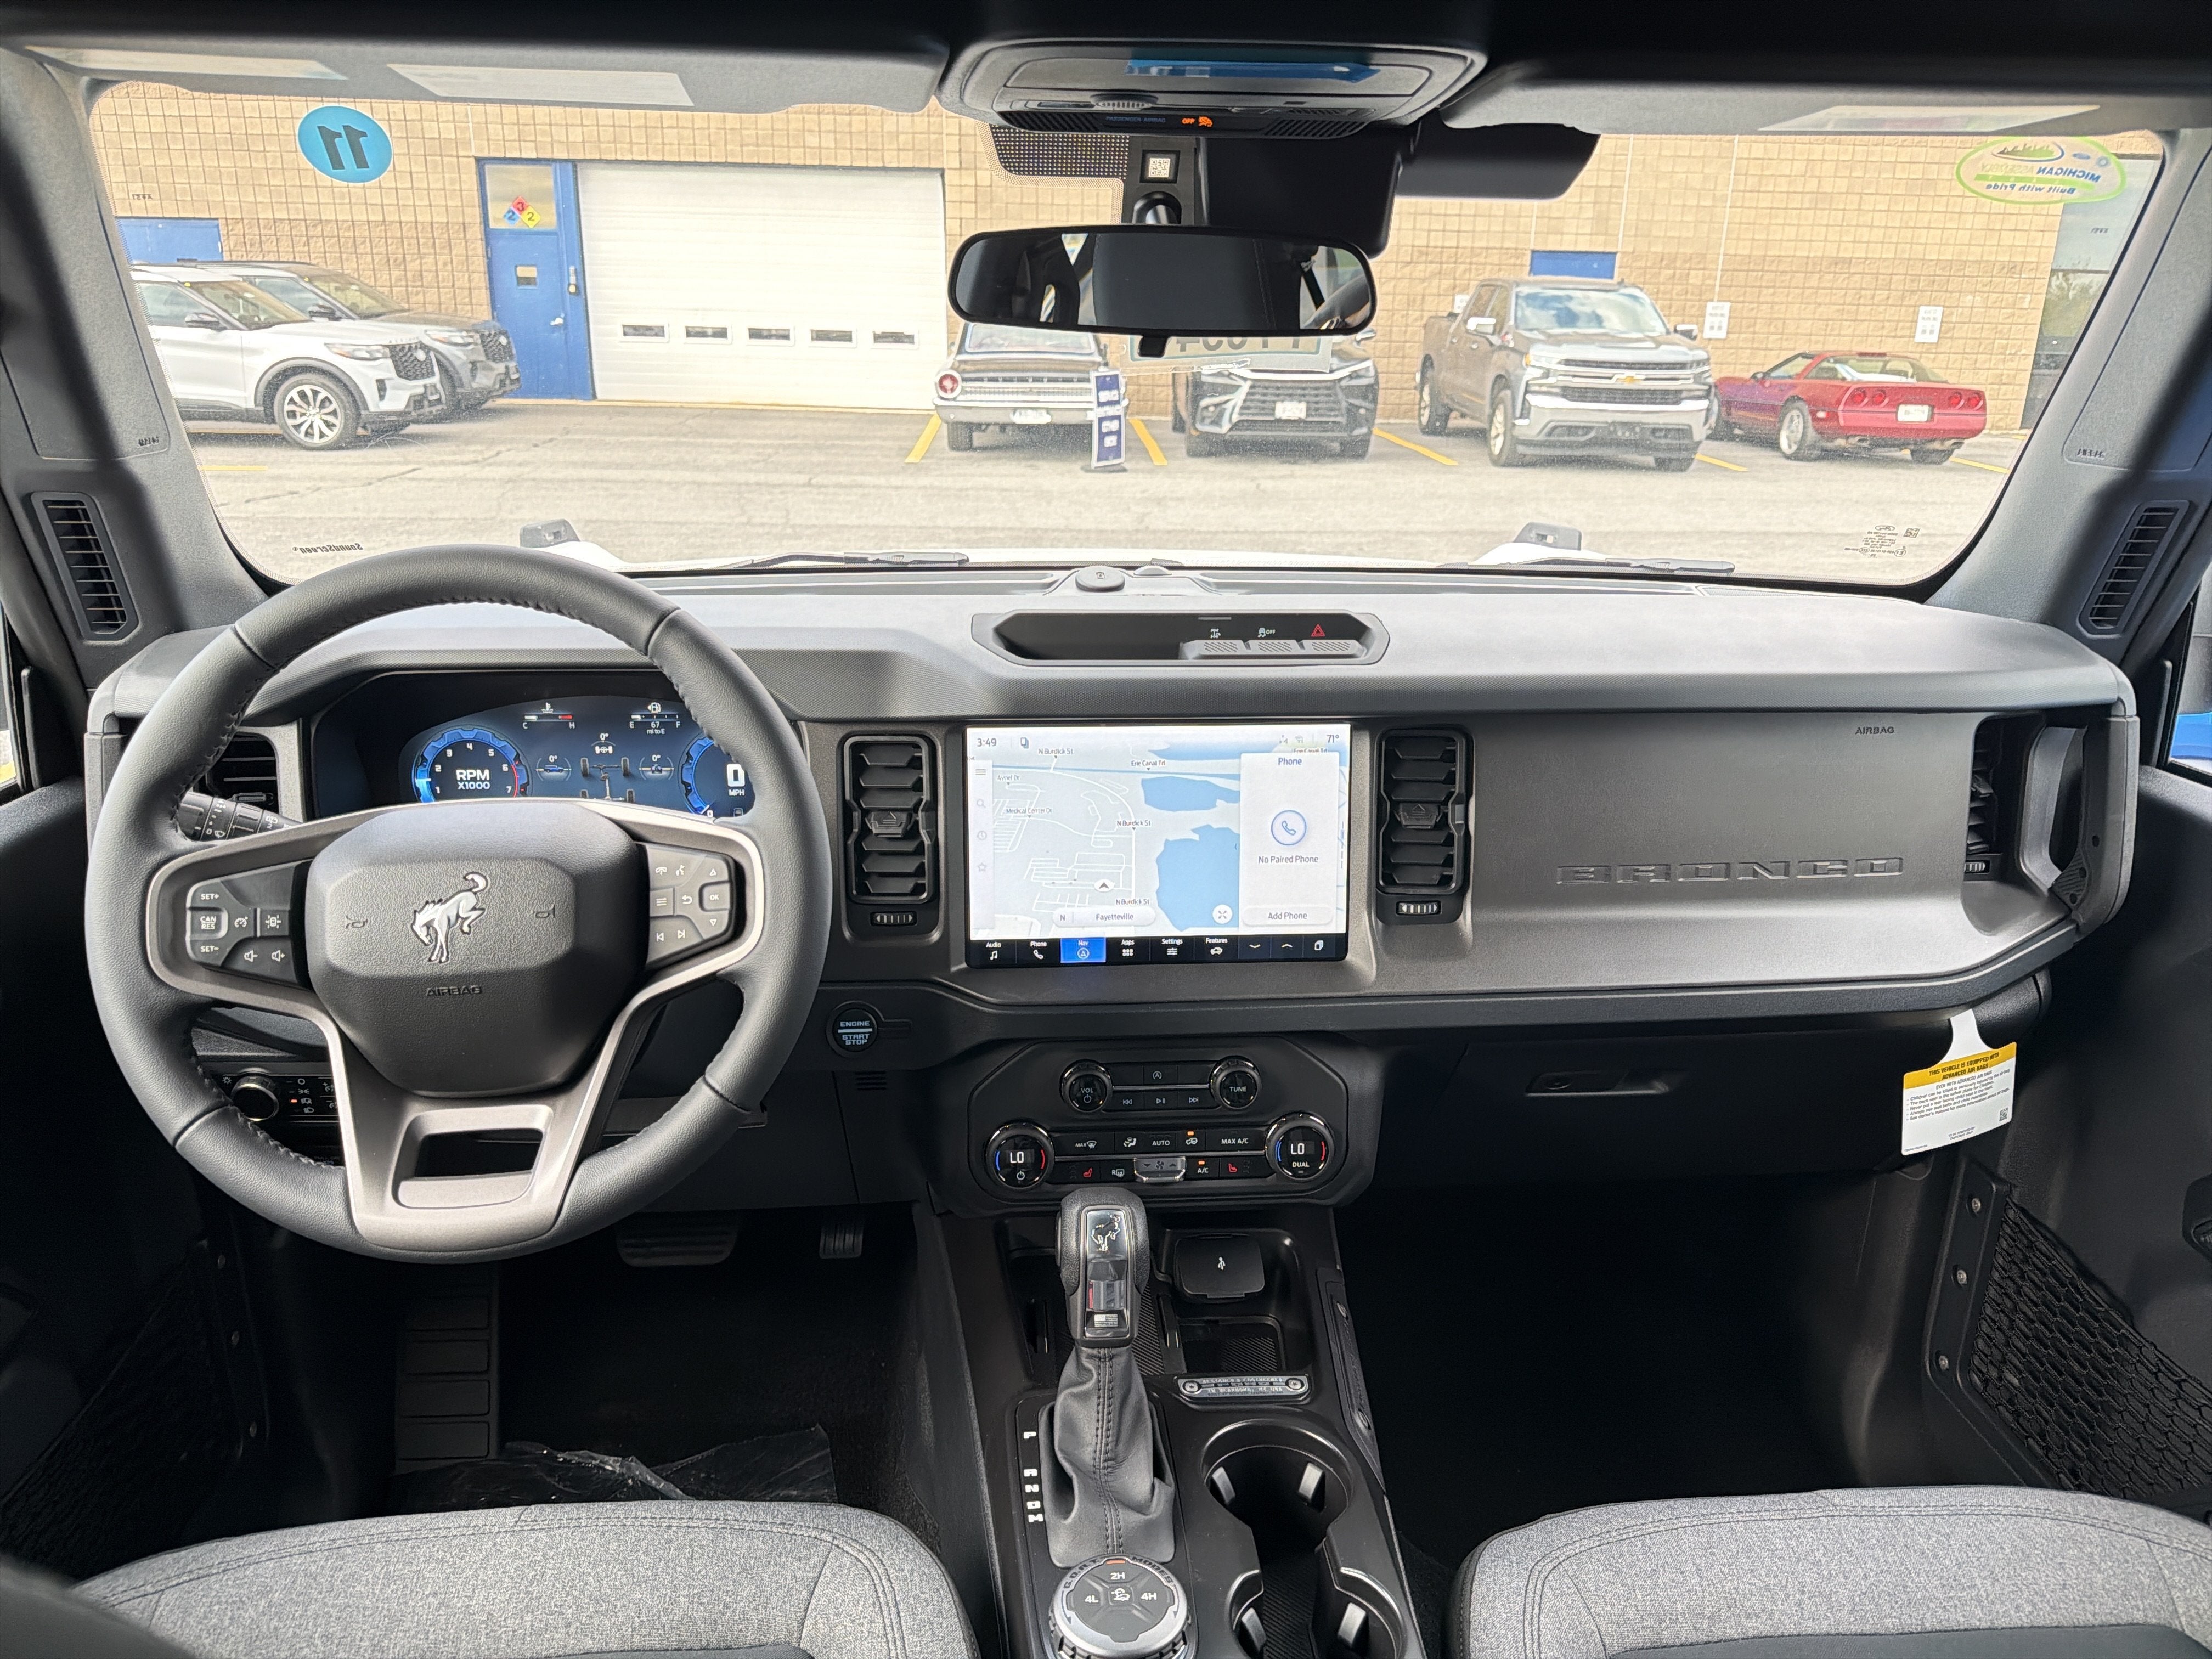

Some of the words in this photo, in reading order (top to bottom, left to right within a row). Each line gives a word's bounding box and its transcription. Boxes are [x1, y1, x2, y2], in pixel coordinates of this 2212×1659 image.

[517, 201, 524, 212] 3
[527, 212, 535, 221] 2
[651, 721, 660, 729] 67
[1855, 726, 1895, 735] AIRBAG
[466, 742, 473, 751] 4
[977, 737, 997, 747] 3:49
[1278, 757, 1302, 765] Phone
[456, 769, 490, 781] RPM
[458, 781, 490, 790] X1000
[1258, 855, 1268, 864] No
[1270, 855, 1293, 864] Paired
[1295, 855, 1319, 864] Phone
[1556, 856, 1904, 885] BRONCO
[1096, 913, 1134, 923] Fayetteville
[1268, 912, 1282, 920] Add
[1284, 912, 1307, 920] Phone
[426, 985, 483, 998] AIRBAG
[1941, 1063, 1960, 1073] VEHICLE
[1966, 1057, 1989, 1066] EQUIPPED
[1989, 1052, 2000, 1060] WITH
[1942, 1070, 1966, 1080] ADVANCED
[1976, 1063, 1989, 1071] BAGS
[1025, 1484, 1039, 1493] N
[1028, 1514, 1043, 1522] M
[1132, 1556, 1174, 1584] MODES
[1110, 1572, 1125, 1580] 2H
[1084, 1595, 1099, 1603] 4L
[1141, 1592, 1157, 1600] 4H
